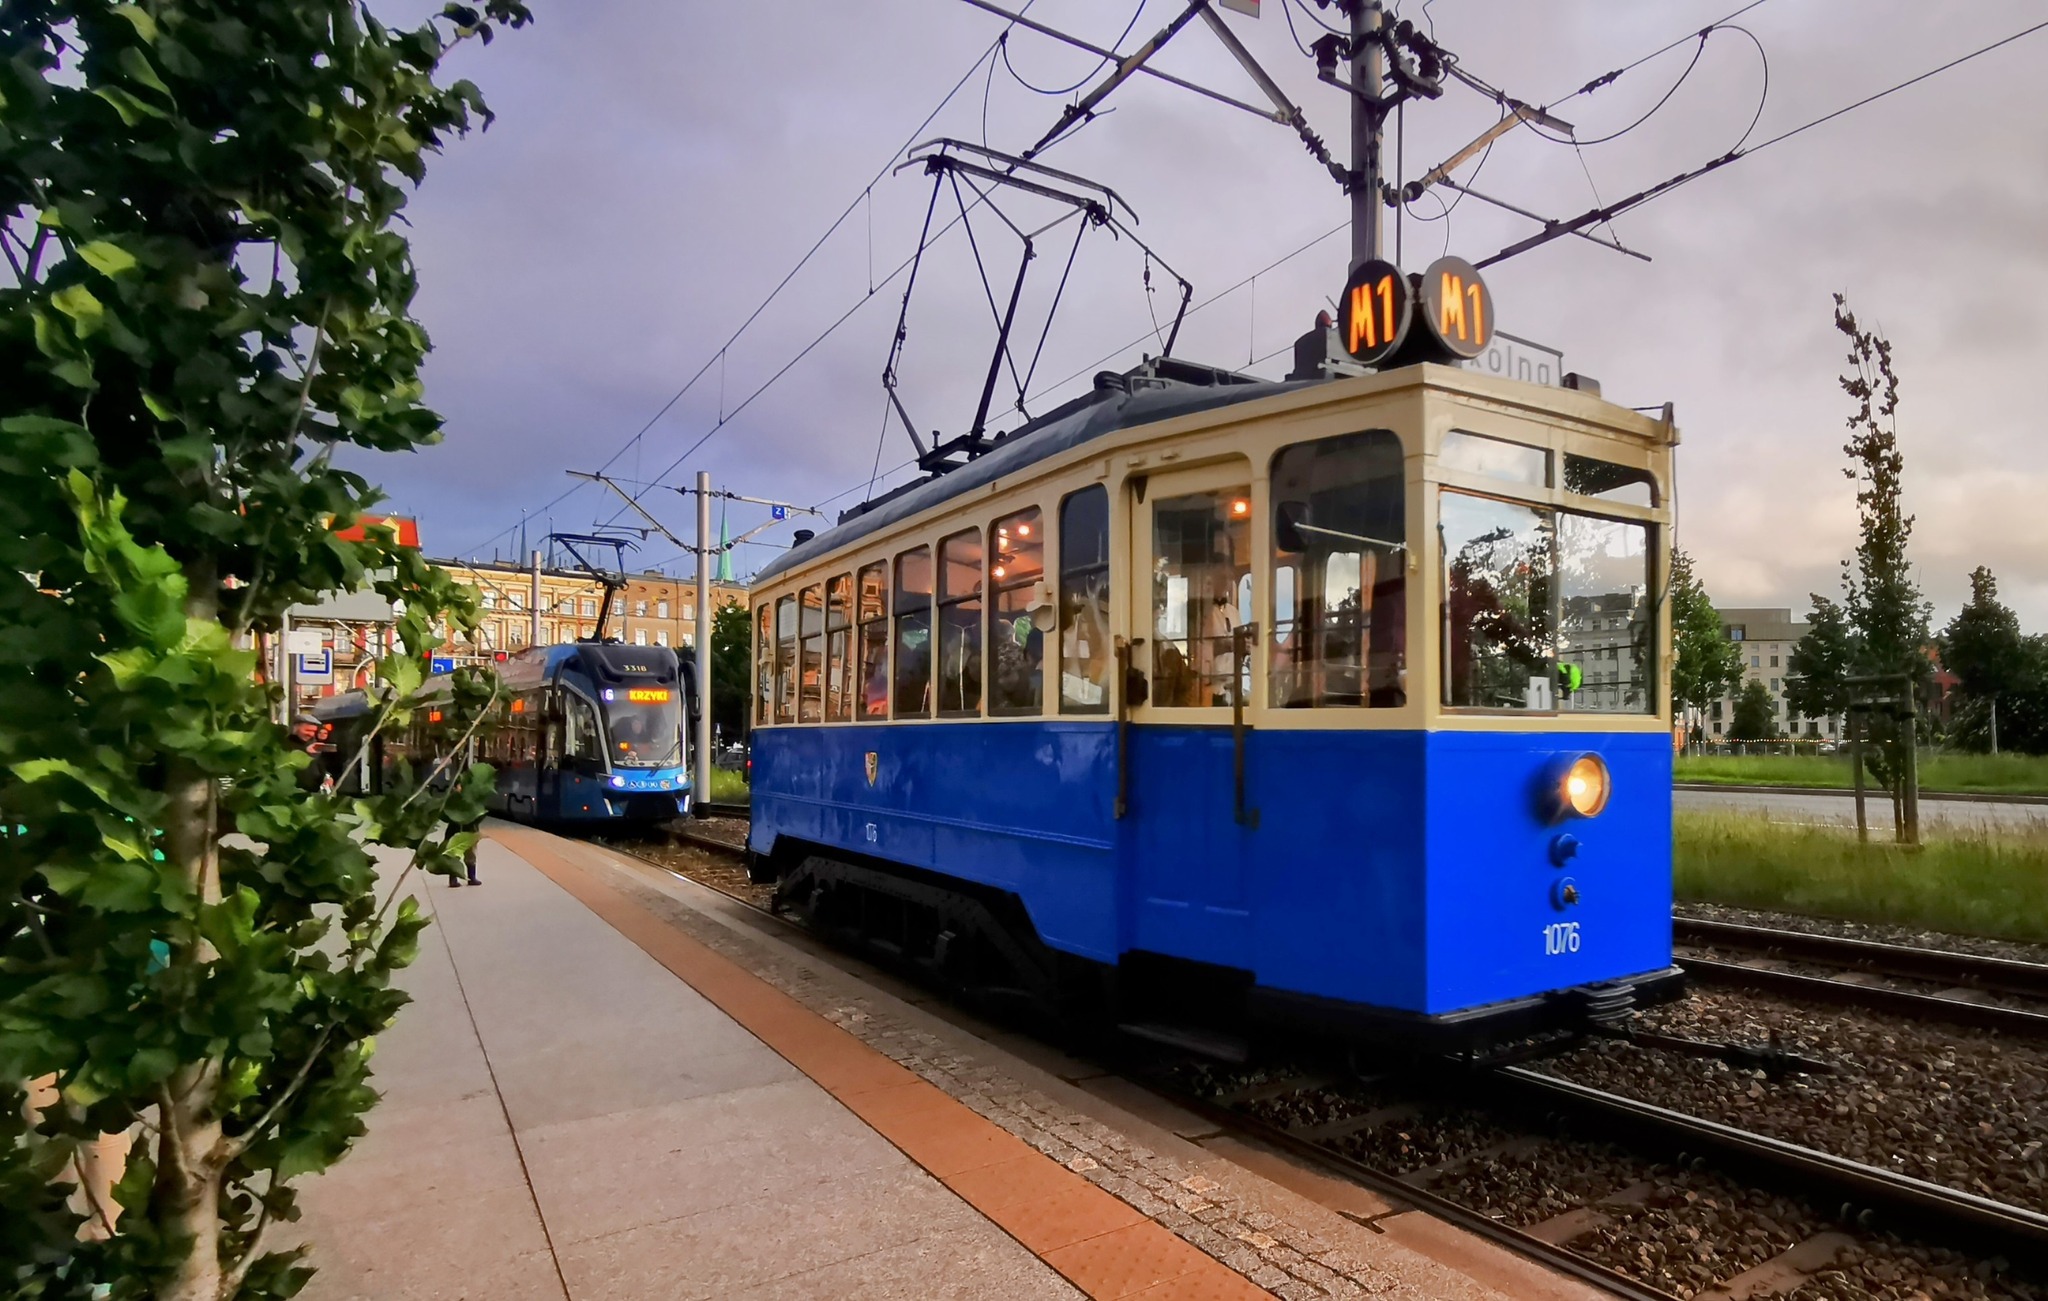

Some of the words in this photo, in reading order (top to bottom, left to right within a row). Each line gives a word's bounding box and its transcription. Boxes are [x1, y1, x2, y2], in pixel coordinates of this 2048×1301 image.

[1350, 274, 1393, 354] M1
[1441, 272, 1483, 345] M1
[605, 689, 614, 701] 6
[629, 689, 668, 701] KRZYKI
[1542, 922, 1580, 955] 1076
